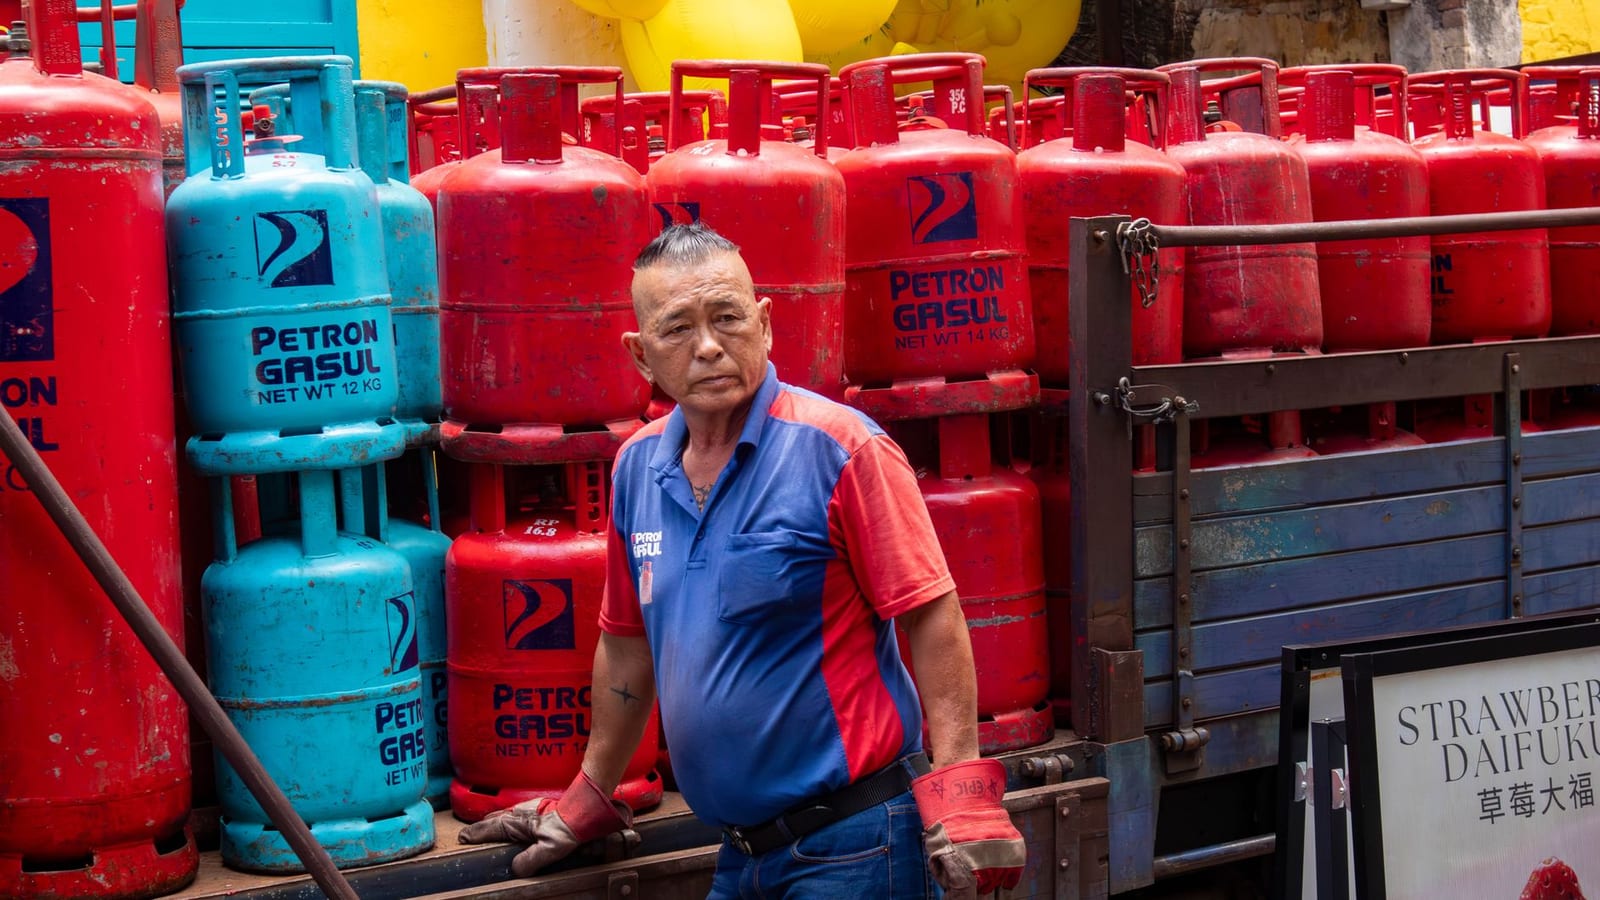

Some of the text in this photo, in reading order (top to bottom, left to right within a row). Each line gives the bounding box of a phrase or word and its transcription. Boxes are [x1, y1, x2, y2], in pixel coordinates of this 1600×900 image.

[890, 266, 1004, 301] PETRON
[893, 296, 1008, 332] GASUL
[251, 319, 378, 356] PETRON
[895, 326, 1009, 350] NET WT 14 KG
[255, 348, 381, 385] GASUL
[258, 378, 382, 405] NET WT 12 KG
[523, 526, 557, 537] 16.8
[534, 518, 560, 526] RP
[1398, 679, 1600, 745] STRAWBER
[496, 742, 531, 757] NET
[535, 742, 566, 756] WT
[1477, 771, 1594, 825] 草莓大福
